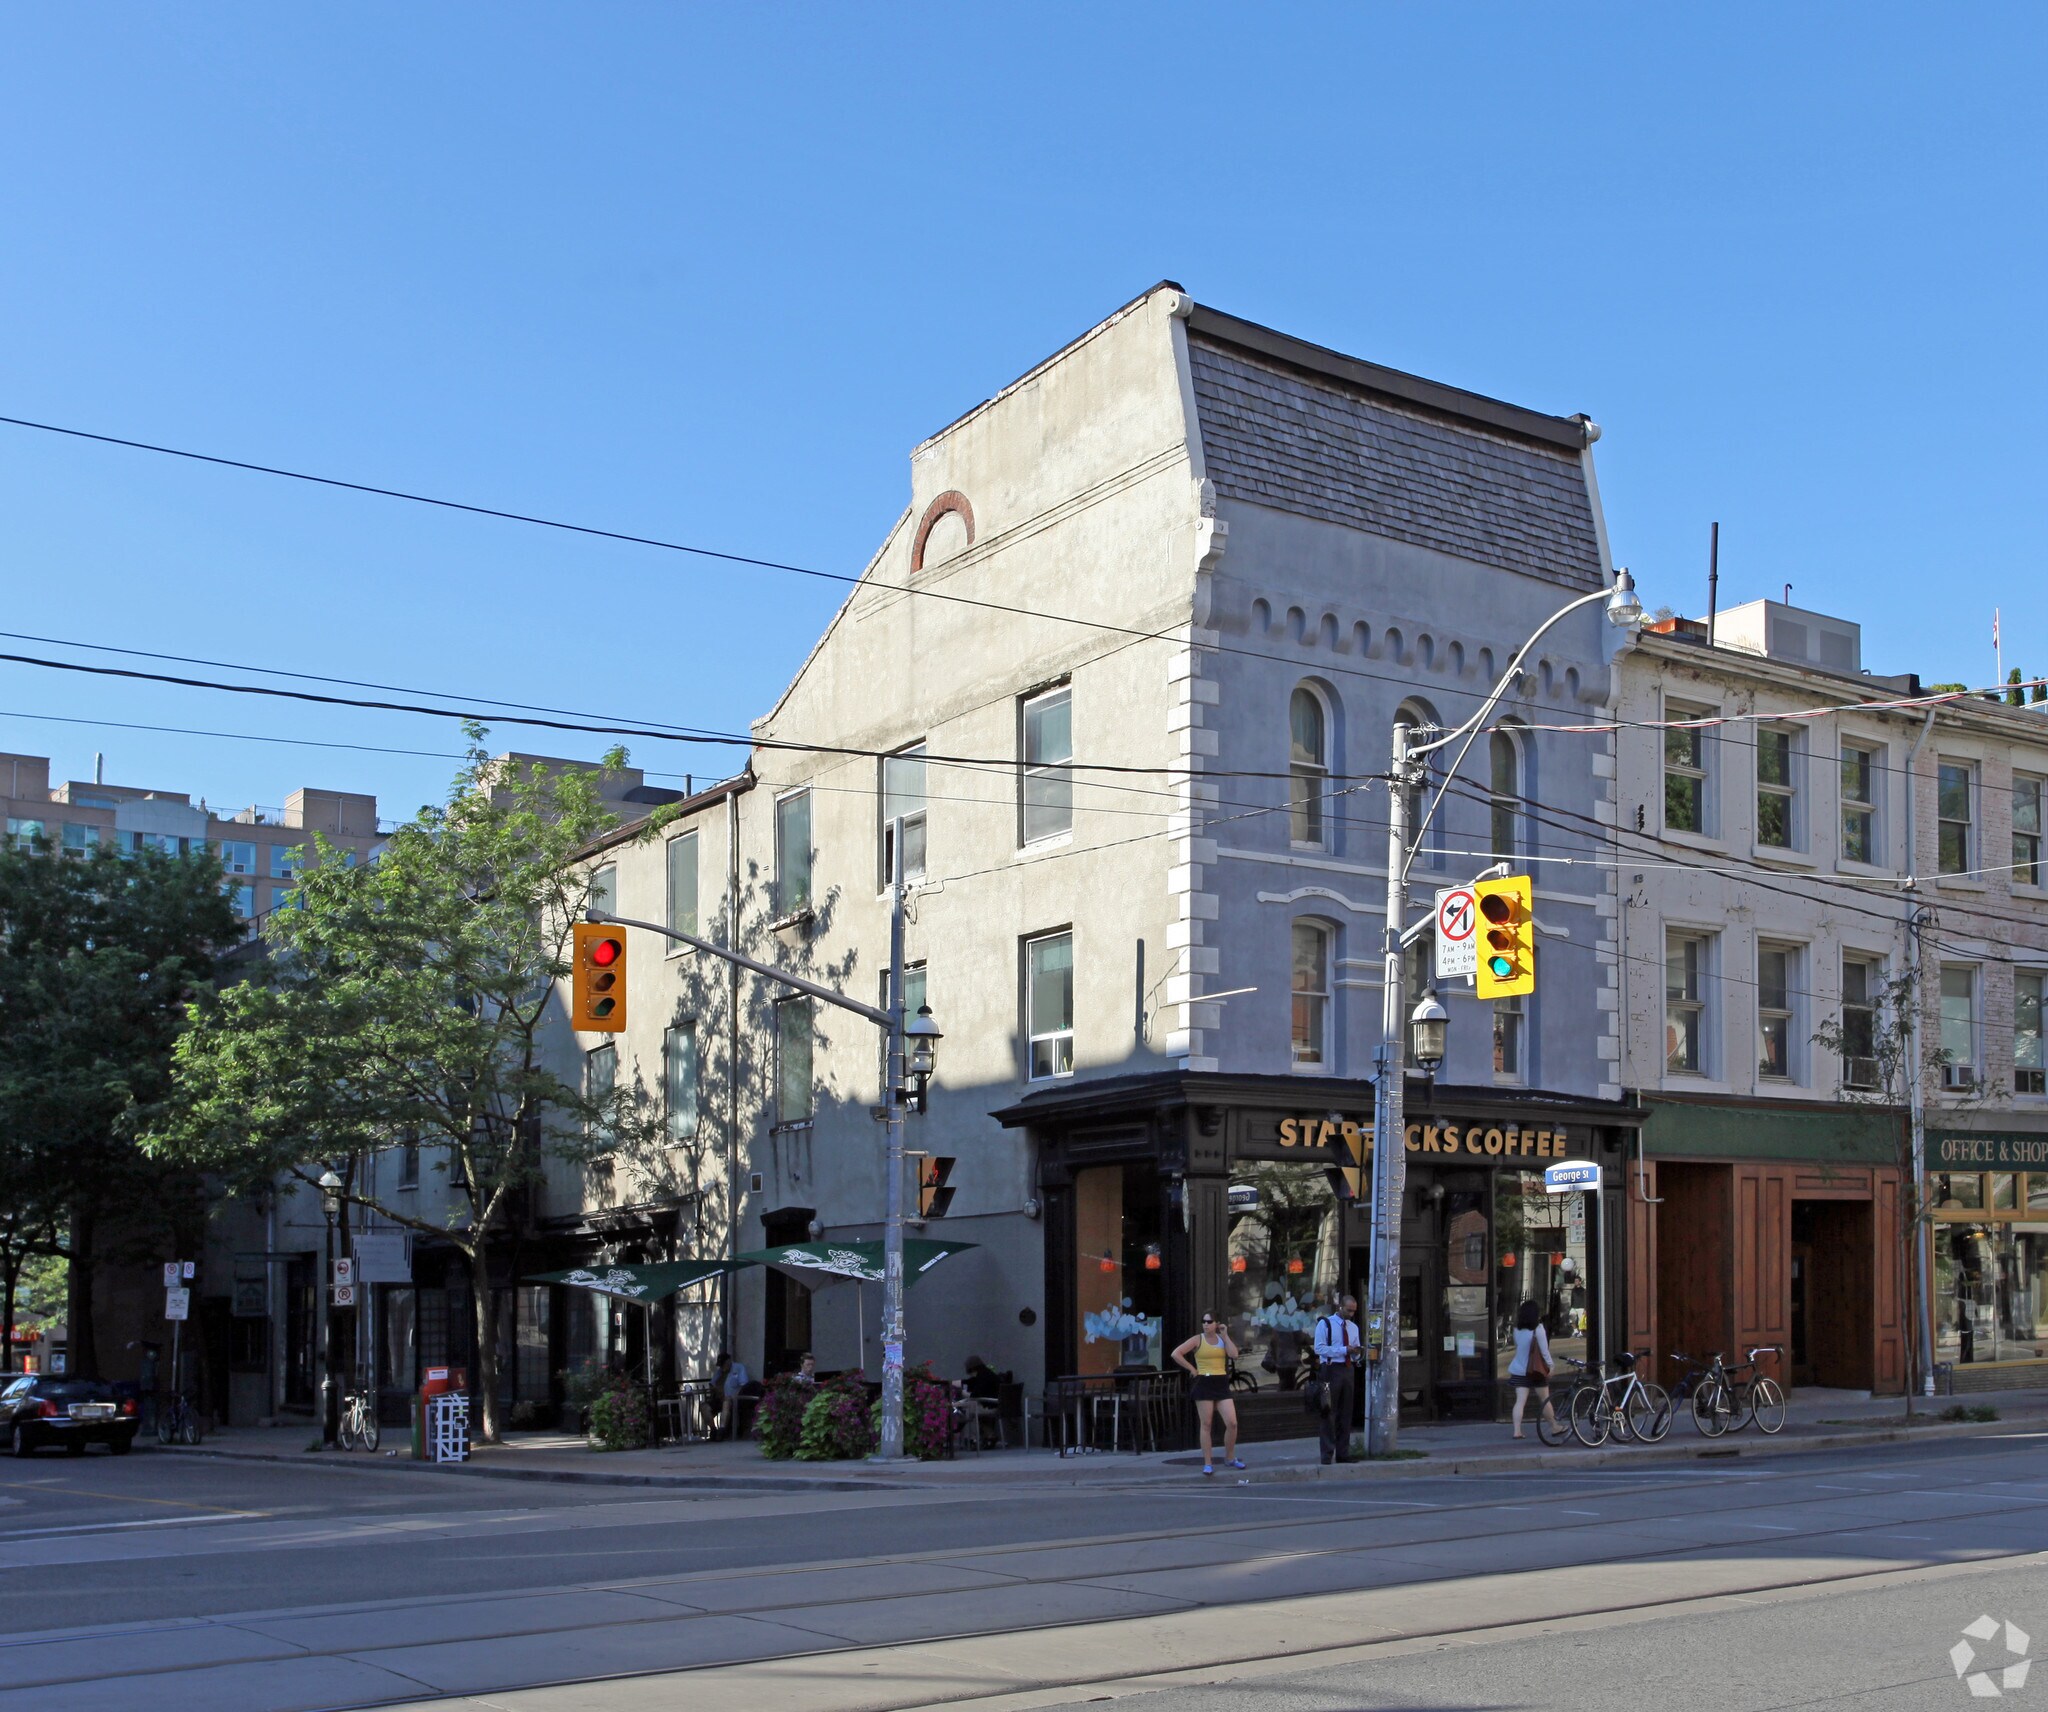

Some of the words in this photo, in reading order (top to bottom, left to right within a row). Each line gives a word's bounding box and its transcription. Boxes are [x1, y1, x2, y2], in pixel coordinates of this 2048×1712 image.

[1466, 1127, 1567, 1157] COFFEE
[1941, 1139, 1995, 1161] OFFICE
[1999, 1140, 2010, 1161] &
[2012, 1140, 2048, 1162] SHOP
[1553, 1171, 1580, 1182] George
